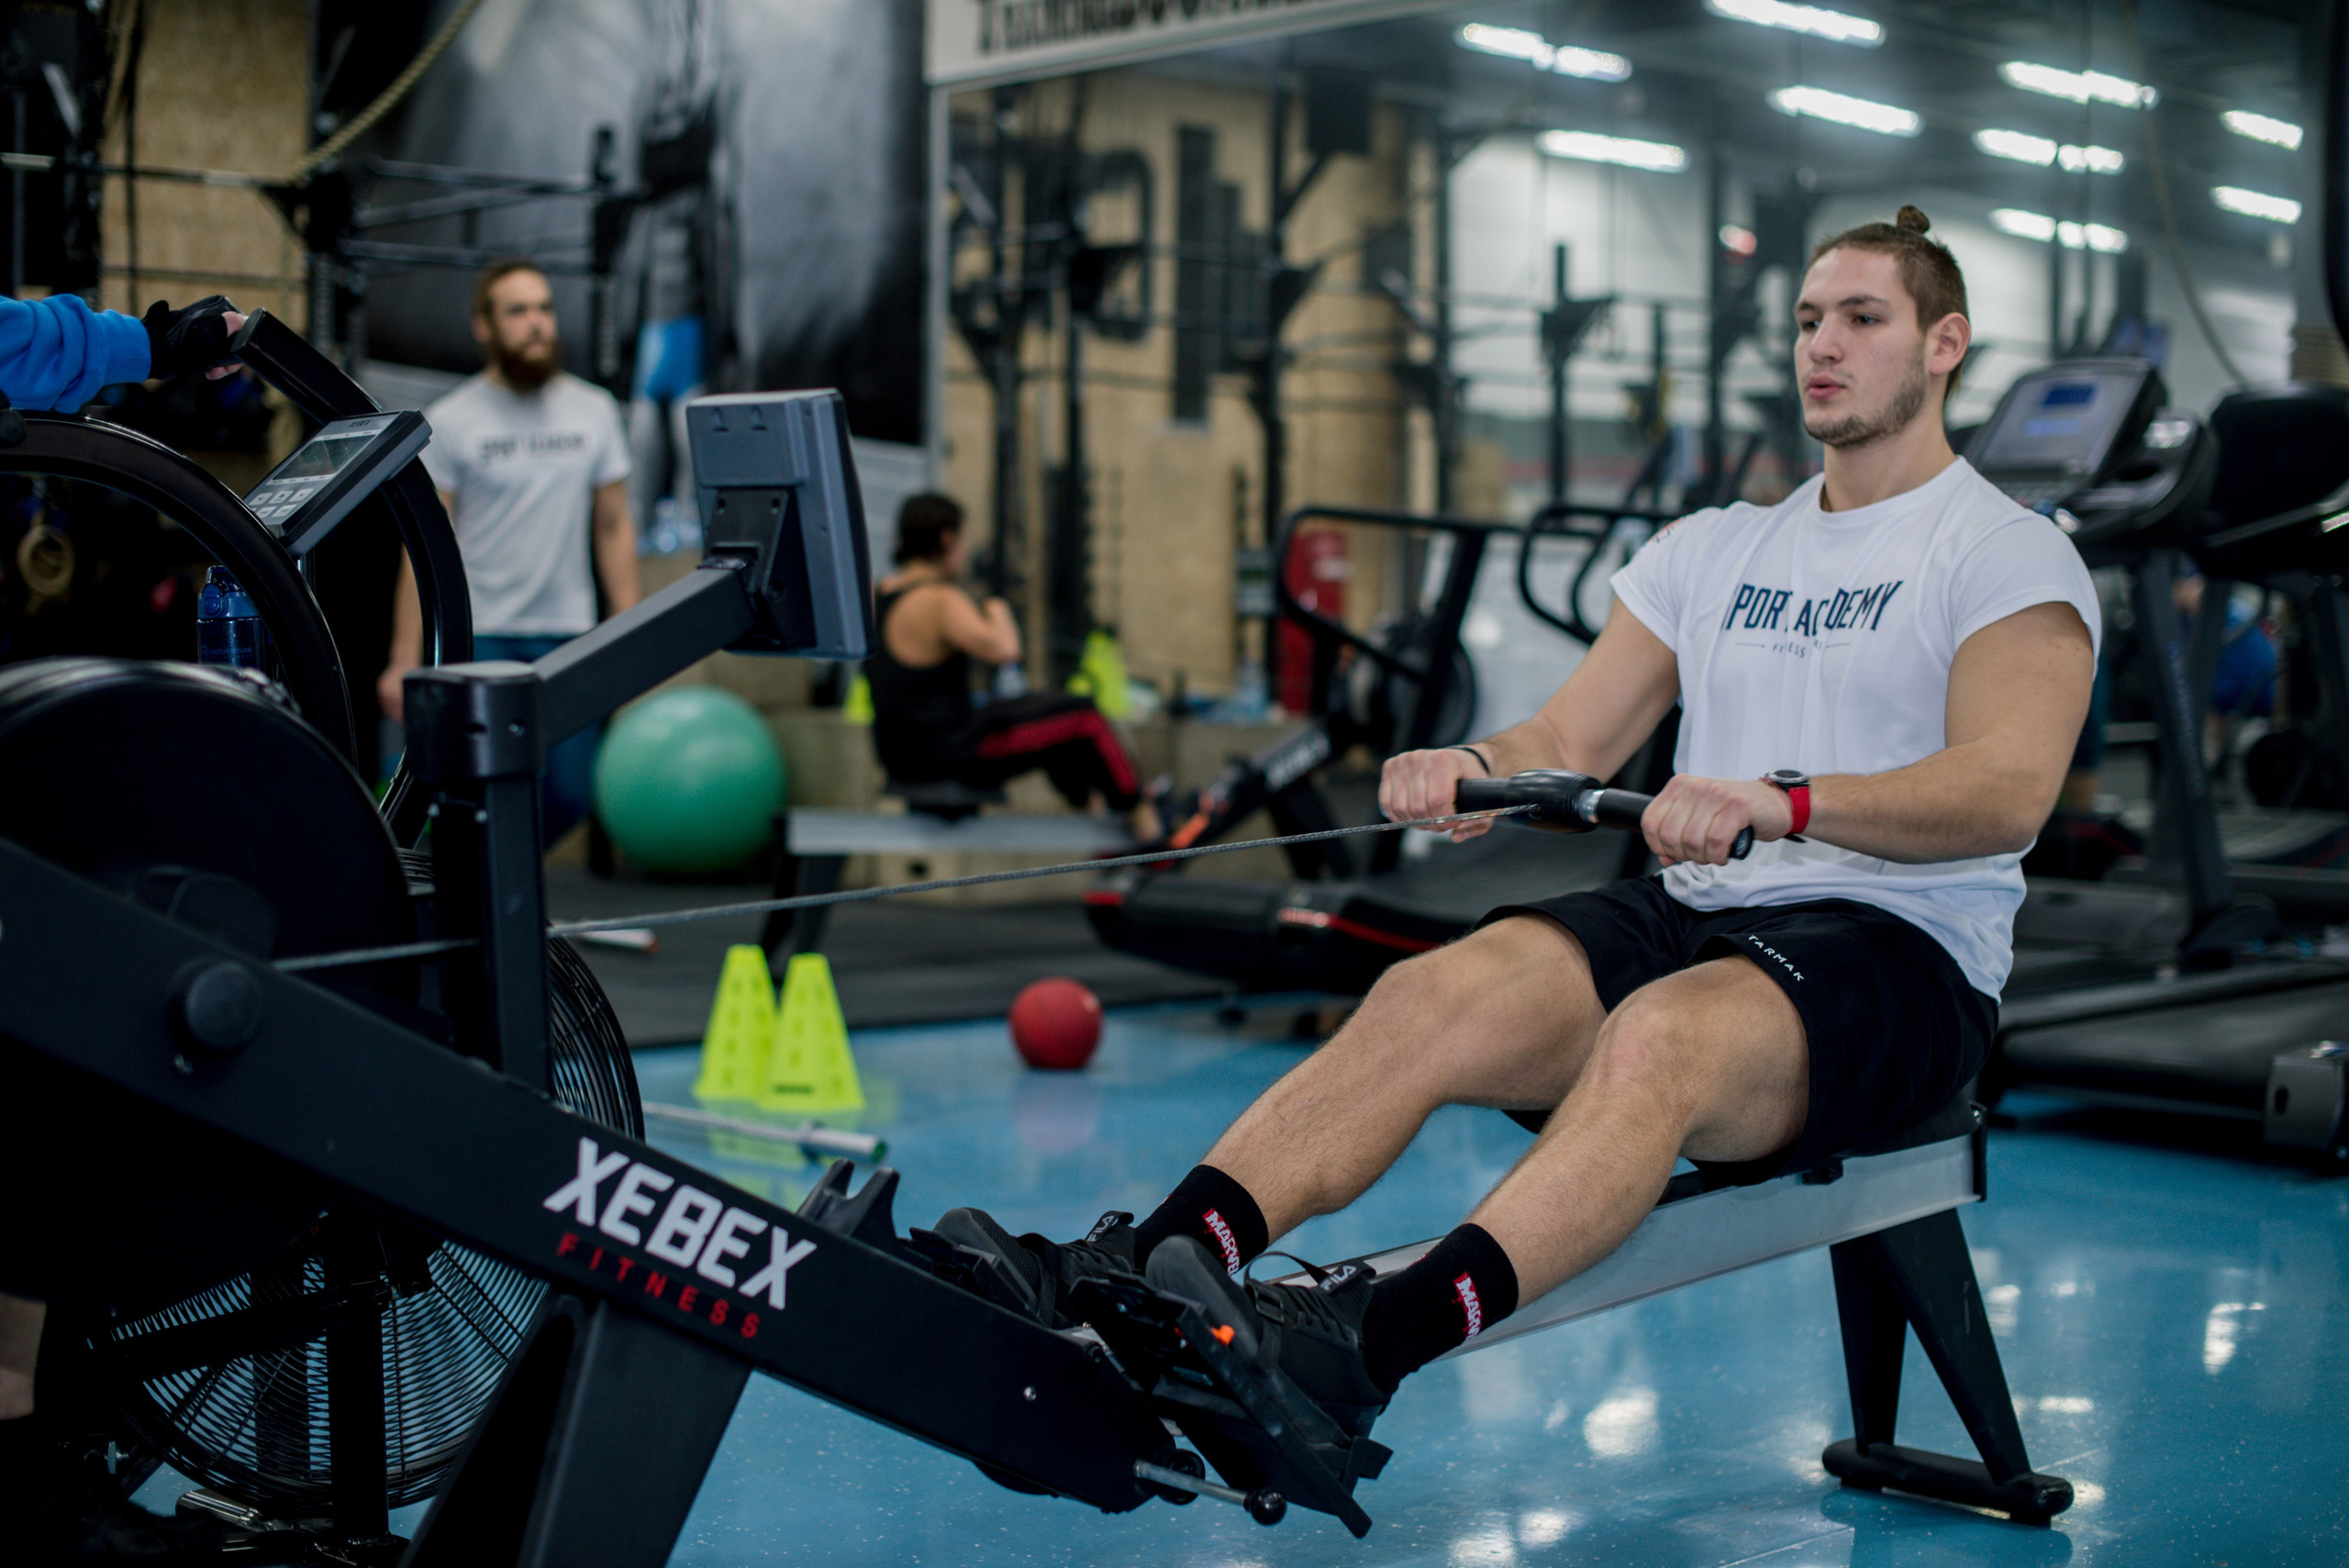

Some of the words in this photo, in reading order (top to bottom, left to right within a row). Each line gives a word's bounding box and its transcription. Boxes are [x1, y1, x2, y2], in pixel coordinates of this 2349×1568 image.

[1720, 583, 1793, 632] POR
[1792, 580, 1904, 637] ACDEMY
[1748, 934, 1805, 982] TARMAK
[542, 1136, 818, 1311] XEBEX
[1086, 1215, 1115, 1242] FILA
[556, 1231, 761, 1340] FITNESS
[1319, 1264, 1357, 1291] FILA
